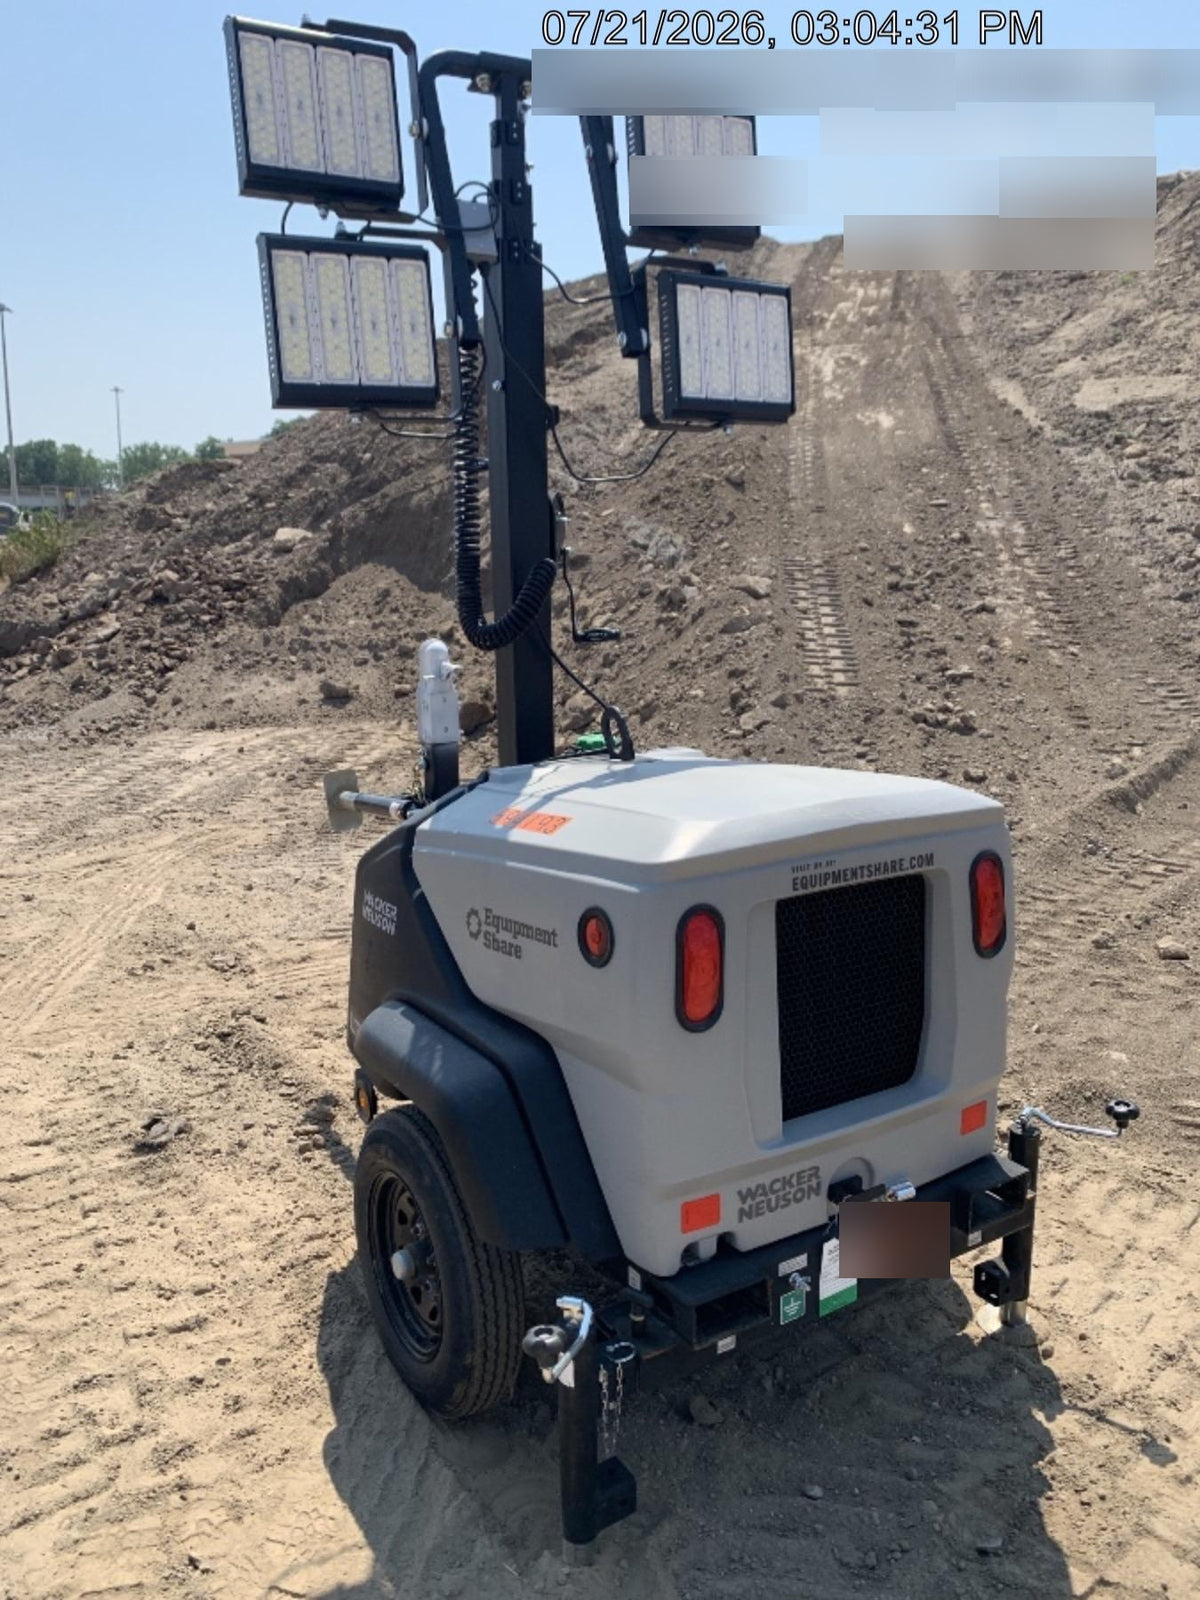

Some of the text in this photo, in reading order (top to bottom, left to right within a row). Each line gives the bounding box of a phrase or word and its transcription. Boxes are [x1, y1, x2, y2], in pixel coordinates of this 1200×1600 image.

[791, 852, 935, 892] EQUIPMENTSHARE.COM
[482, 906, 559, 948] Equipment
[482, 931, 523, 960] Share
[736, 1165, 821, 1205] WACKER
[737, 1180, 822, 1224] NEUSON
